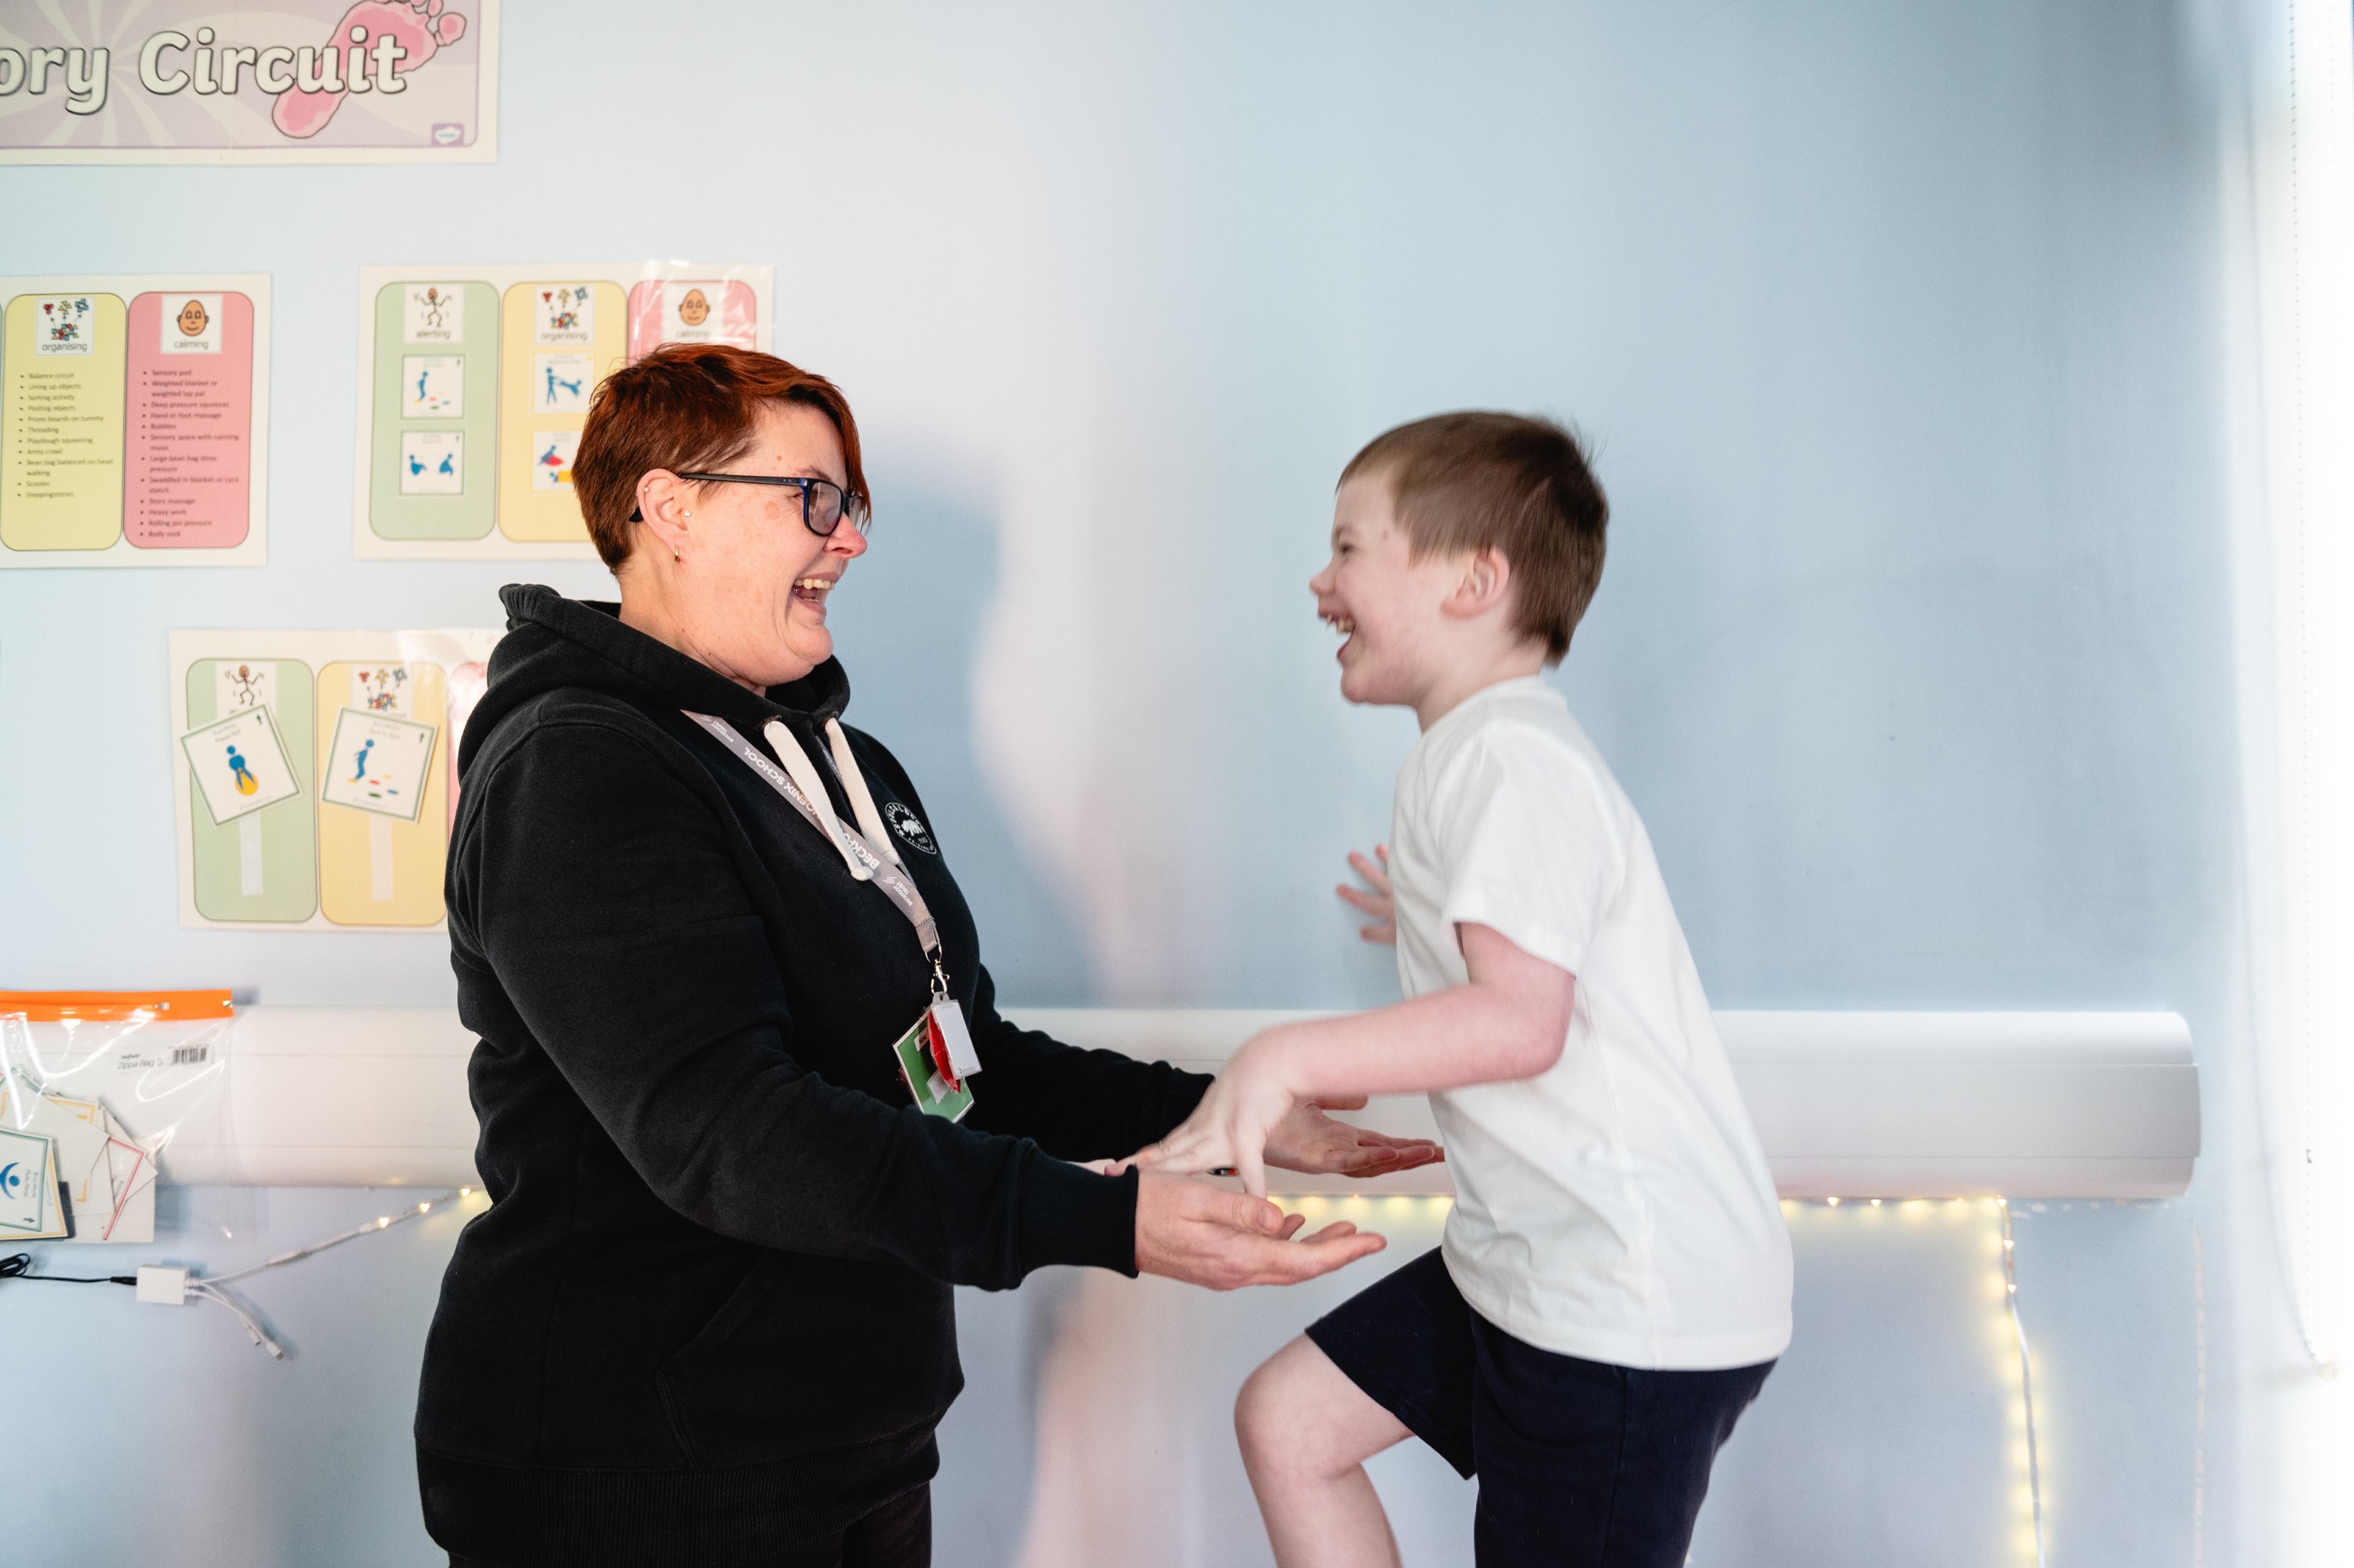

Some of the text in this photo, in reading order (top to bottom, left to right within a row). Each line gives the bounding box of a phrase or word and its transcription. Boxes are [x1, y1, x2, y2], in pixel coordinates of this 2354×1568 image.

[138, 25, 408, 95] Circuit
[415, 329, 451, 340] alerting
[540, 332, 588, 343] organising
[43, 342, 87, 352] organising
[174, 339, 209, 349] calming
[710, 722, 735, 743] BECKFOOT
[713, 721, 728, 734] TRUST
[744, 747, 786, 786] SCHOOL
[783, 782, 819, 818] OENIX
[840, 830, 880, 870] BECKFO
[896, 881, 910, 895] TRUST
[893, 885, 913, 907] BECKFOOT
[117, 1061, 138, 1069] Zippa
[139, 1059, 155, 1067] Bag
